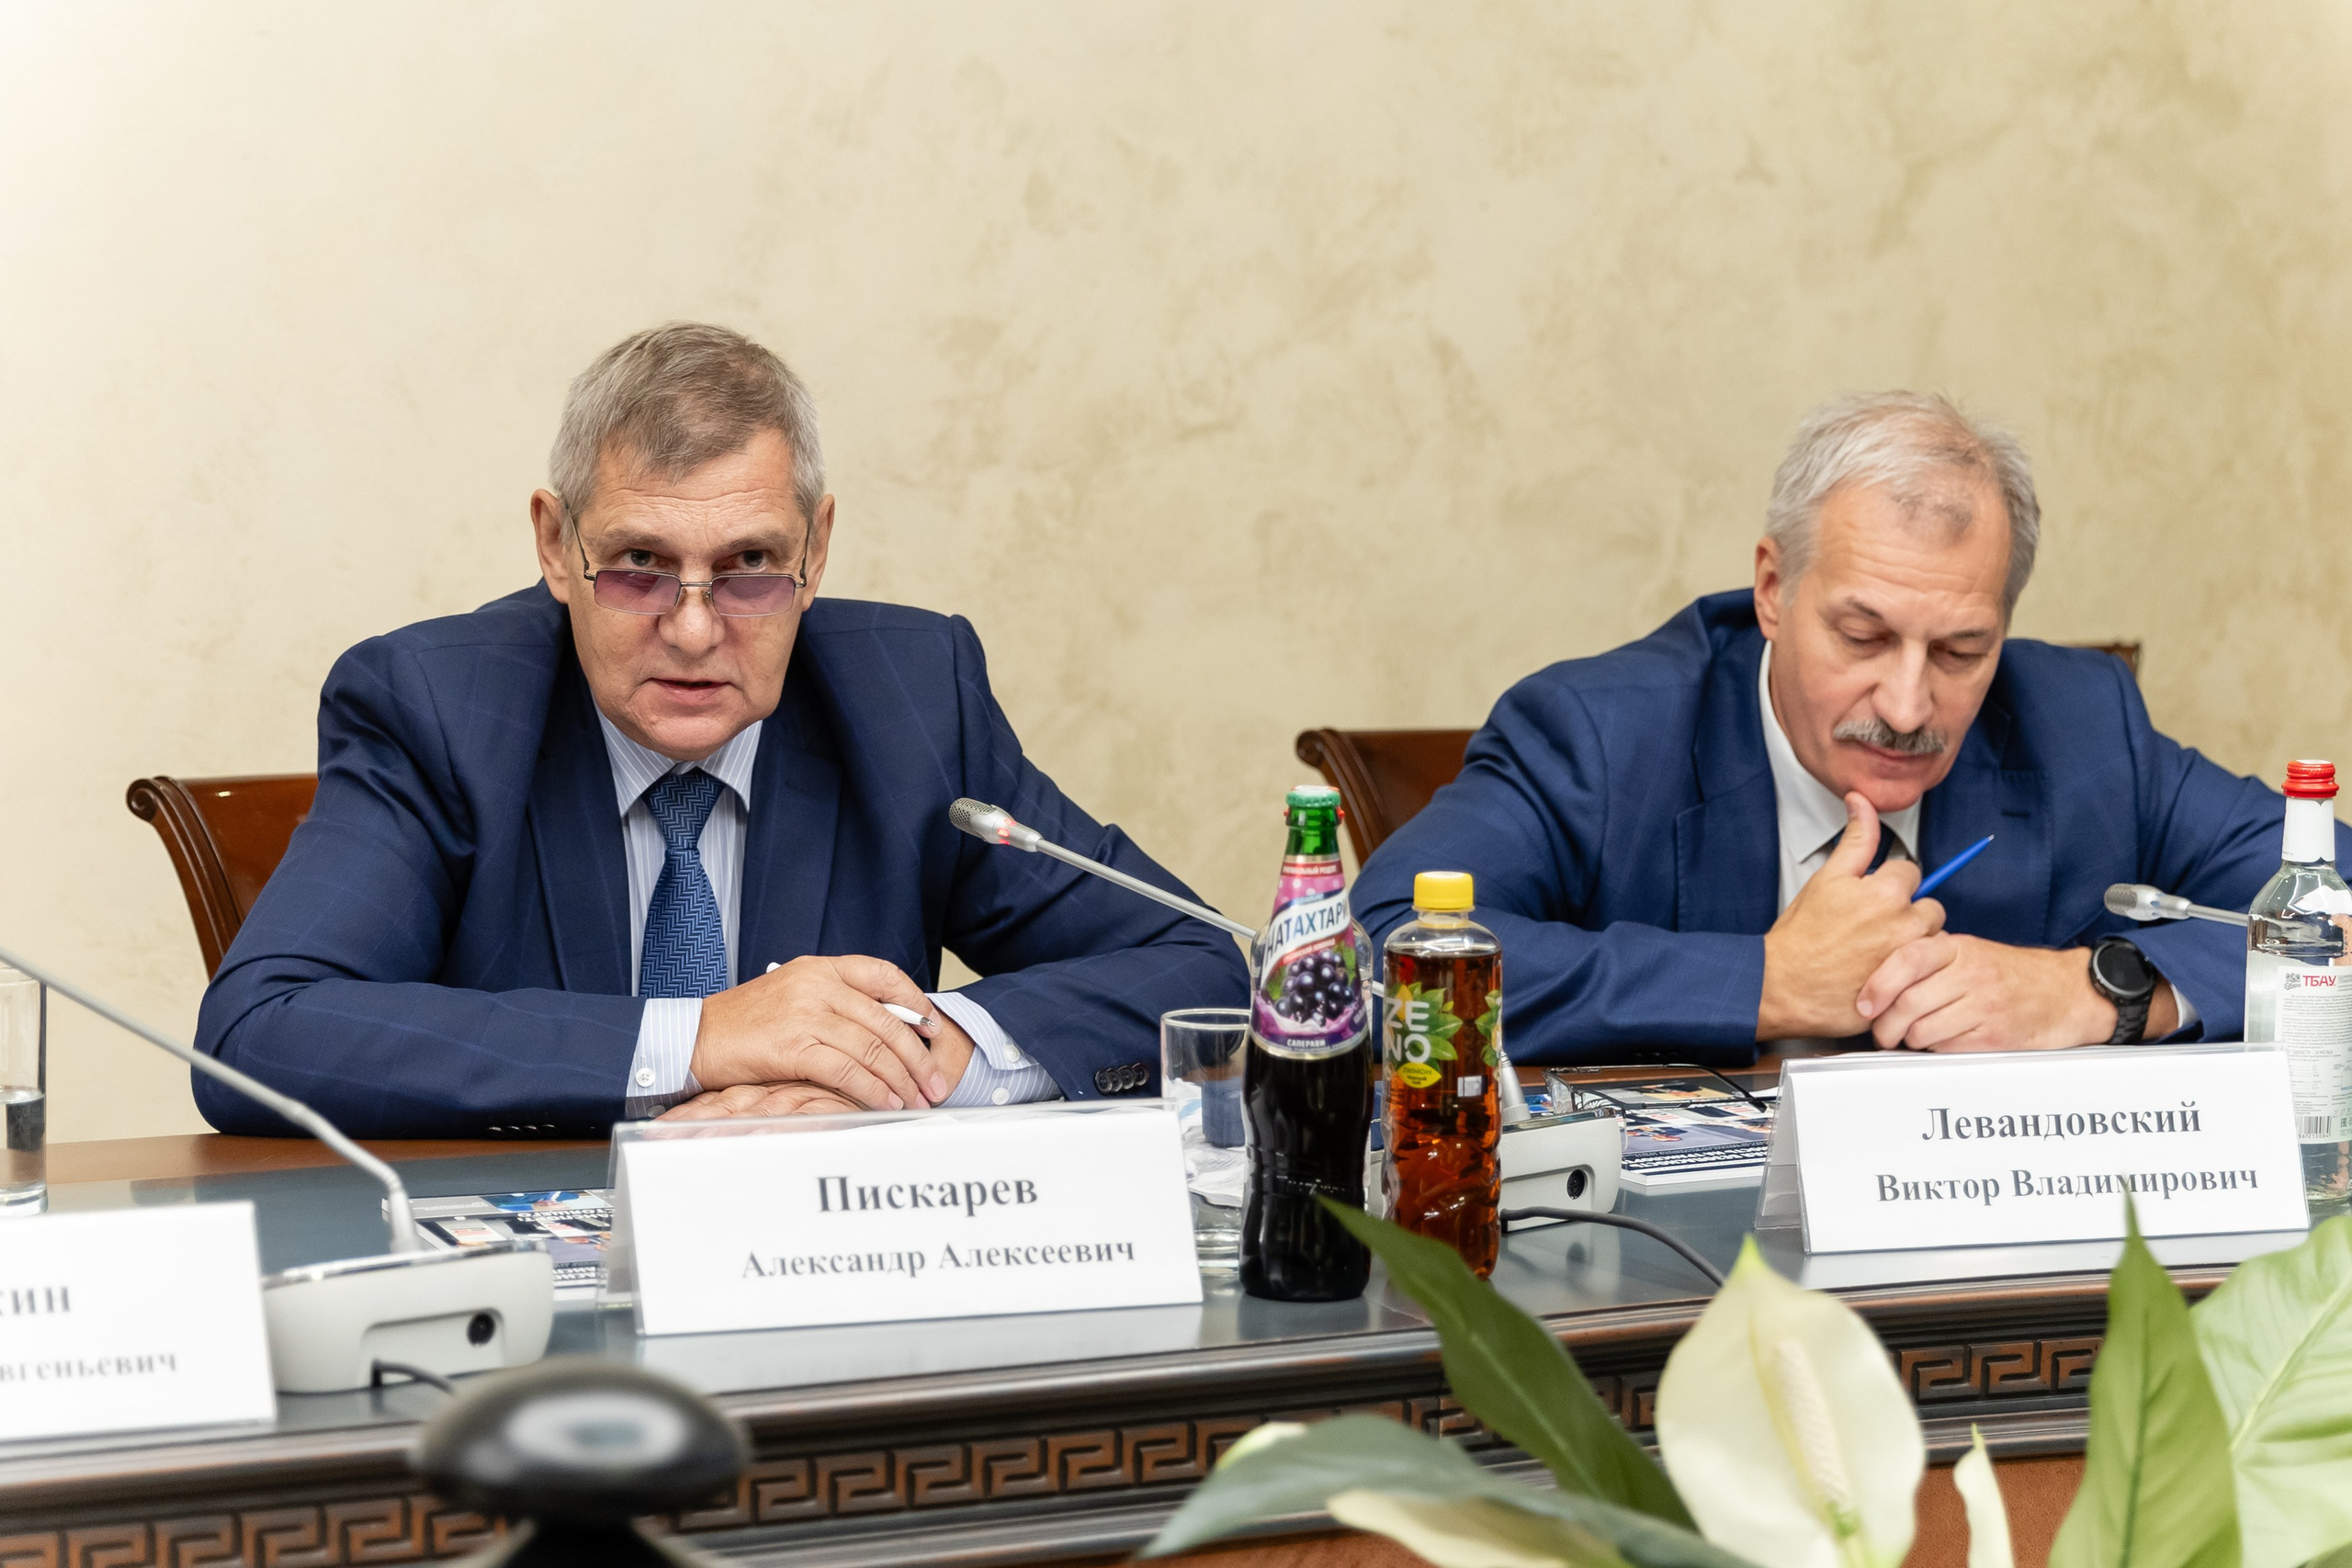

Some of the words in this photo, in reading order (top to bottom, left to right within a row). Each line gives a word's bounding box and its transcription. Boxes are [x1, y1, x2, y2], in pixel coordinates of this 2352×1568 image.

[2302, 975, 2336, 987] ТБАУ
[1286, 1038, 1326, 1047] САПЕРАВИ
[1922, 1100, 2201, 1141] Левандовский
[818, 1175, 1038, 1217] Пискарев
[1877, 1173, 2000, 1206] Виктор
[2011, 1167, 2259, 1200] Владимирович
[741, 1251, 925, 1278] Александр
[939, 1243, 1135, 1269] Алексеевич
[0, 1353, 176, 1382] вгеньевич
